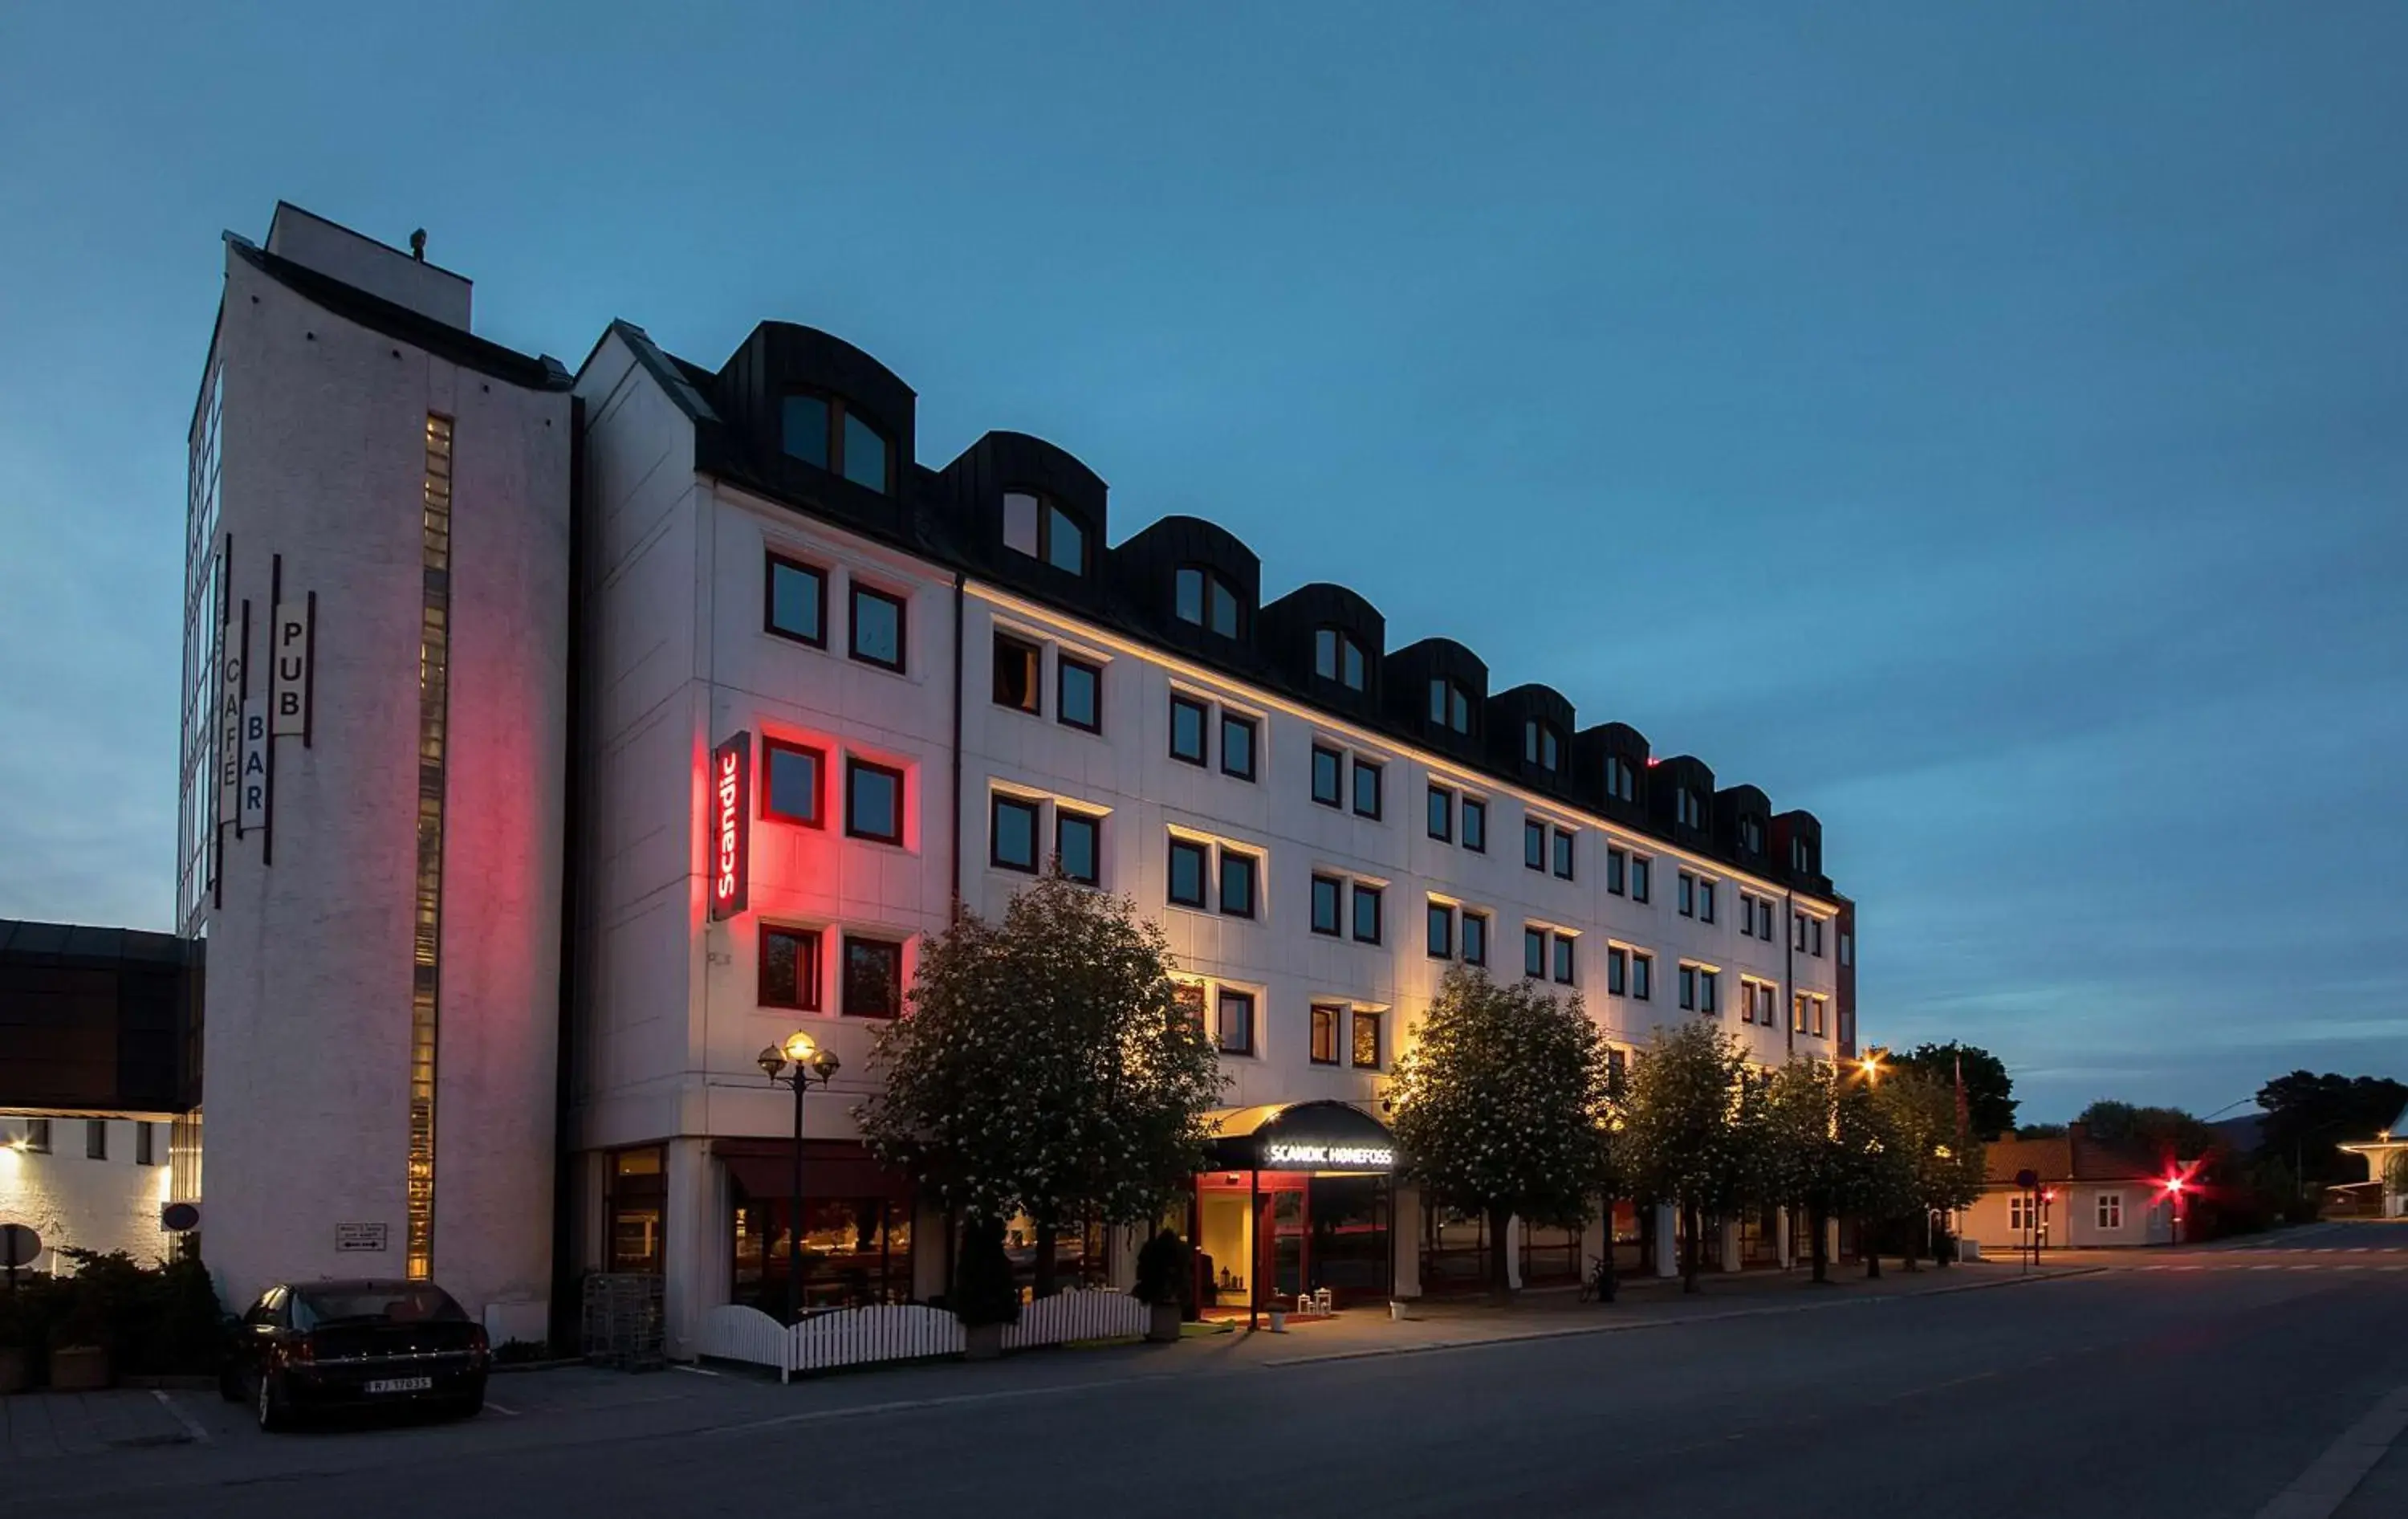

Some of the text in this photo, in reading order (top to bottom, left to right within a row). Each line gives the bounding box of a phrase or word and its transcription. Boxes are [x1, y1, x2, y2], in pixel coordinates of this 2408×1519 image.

[281, 621, 303, 716] PUB
[224, 658, 241, 786] CAFÉ
[246, 715, 264, 810] BAR
[718, 751, 737, 899] Scandic
[1271, 1145, 1328, 1162] SCANDIC
